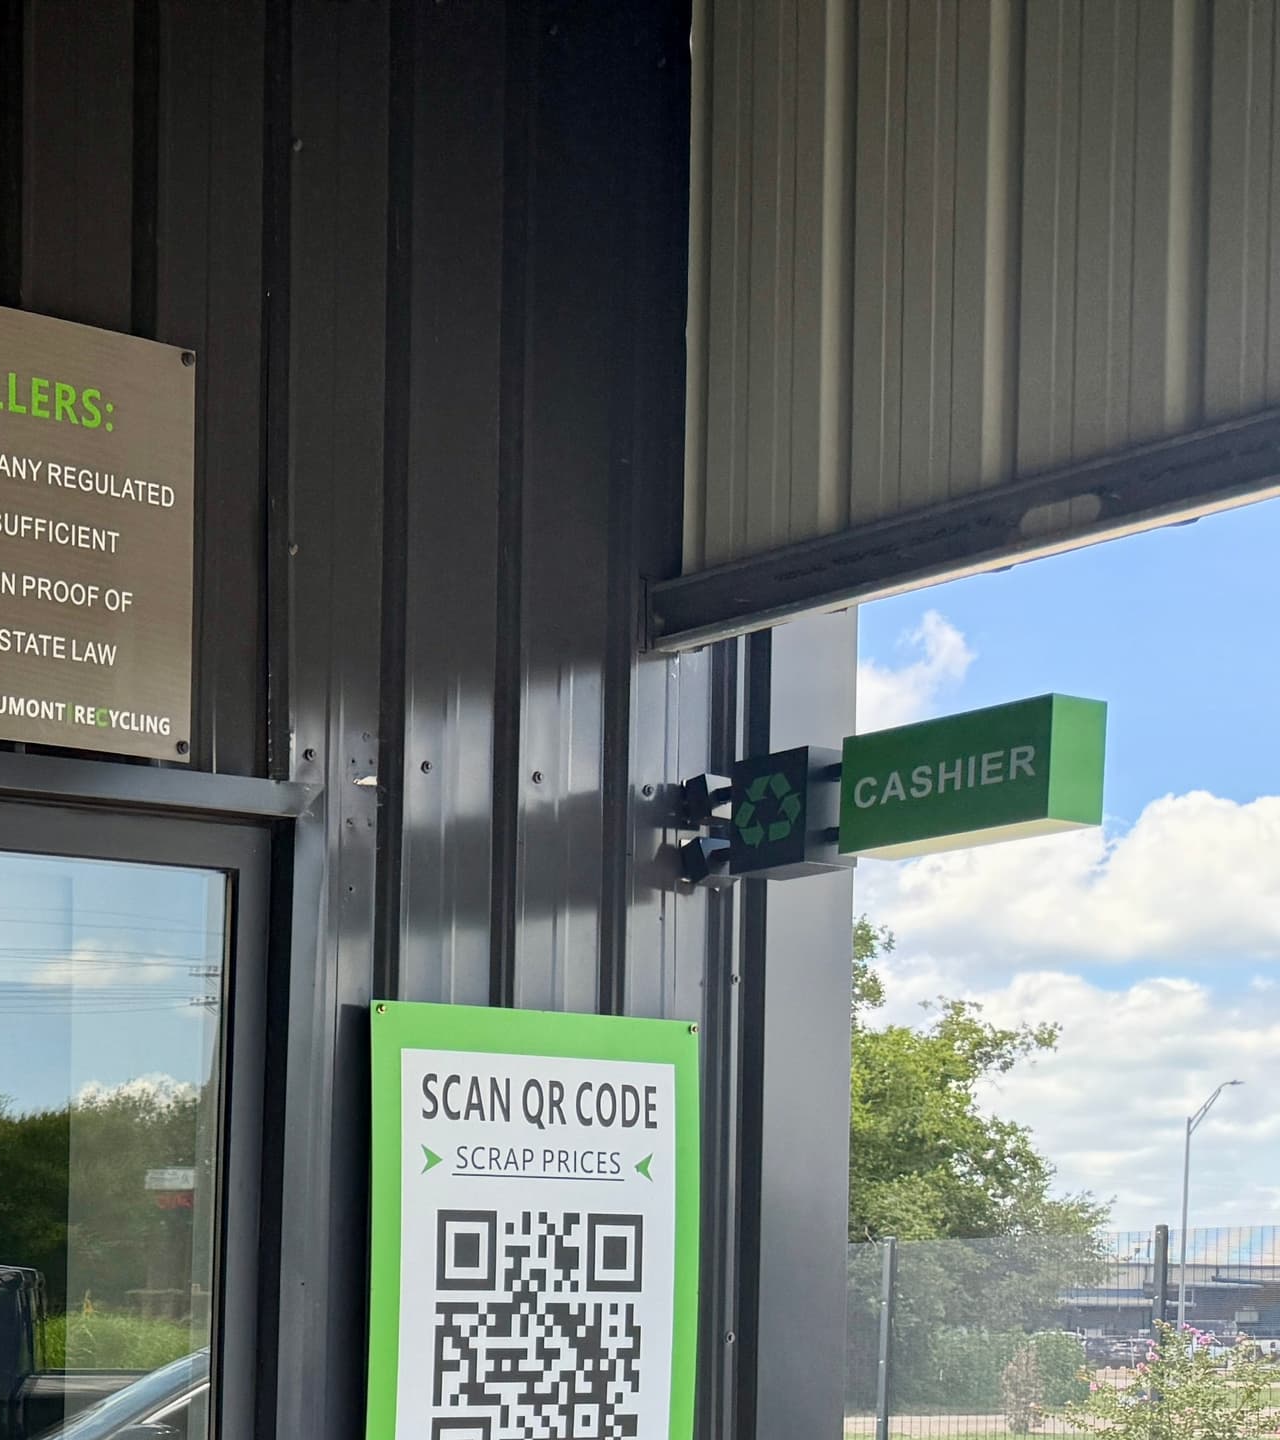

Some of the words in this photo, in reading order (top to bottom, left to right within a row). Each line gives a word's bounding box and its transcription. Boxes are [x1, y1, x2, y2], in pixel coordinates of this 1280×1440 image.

[47, 462, 175, 508] REGULATED
[22, 575, 100, 607] PROOF
[104, 588, 133, 613] OF
[72, 639, 117, 666] LAW
[74, 705, 170, 736] RECYCLING
[853, 745, 1037, 809] CASHIER
[422, 1073, 511, 1123] SCAN
[522, 1078, 567, 1130] QR
[575, 1081, 658, 1129] CODE
[456, 1145, 534, 1171] SCRAP
[543, 1149, 621, 1175] PRICES
